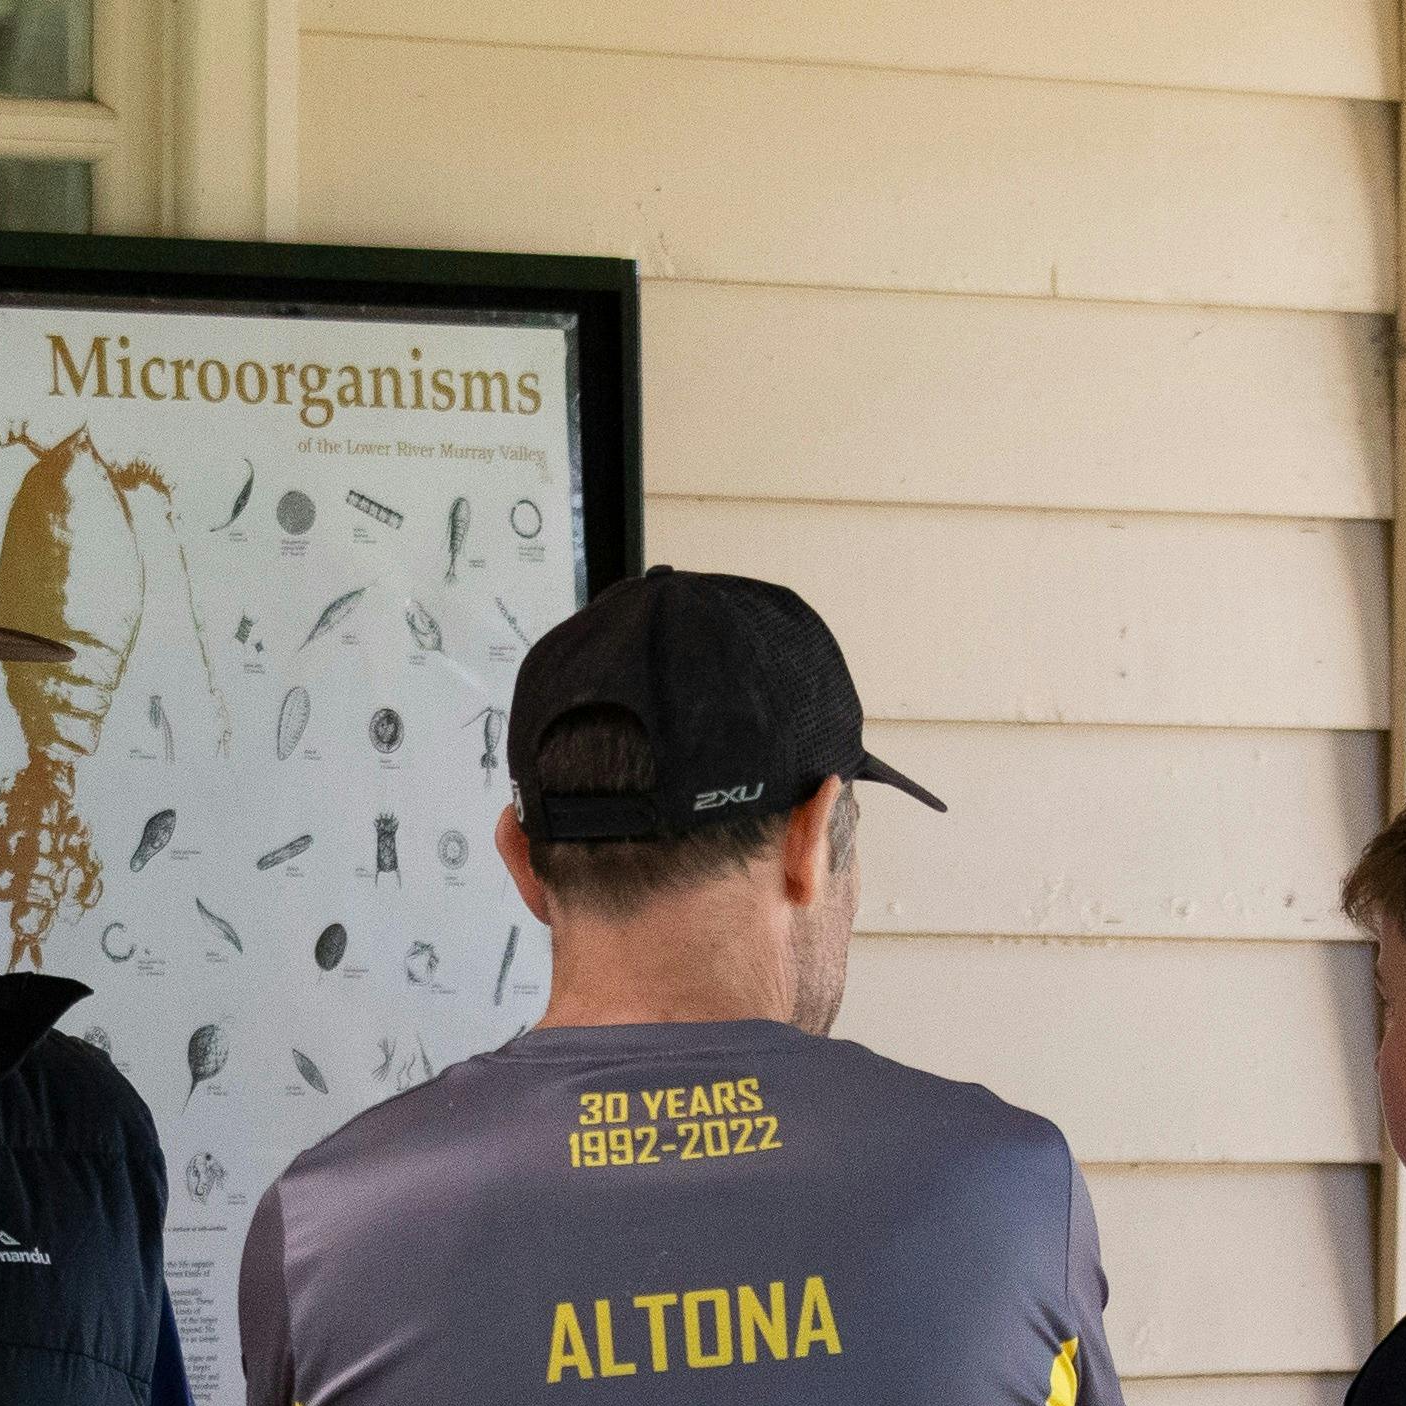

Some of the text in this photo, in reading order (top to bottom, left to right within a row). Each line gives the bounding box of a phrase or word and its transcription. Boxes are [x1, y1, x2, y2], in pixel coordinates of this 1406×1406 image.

[46, 335, 543, 428] Microorganisms
[297, 438, 545, 463] of the Lower River Murray Valley
[694, 782, 764, 811] 2XU
[578, 1077, 763, 1126] 30 YEARS
[568, 1115, 783, 1168] 1992-2022
[546, 1274, 842, 1384] ALTONA
